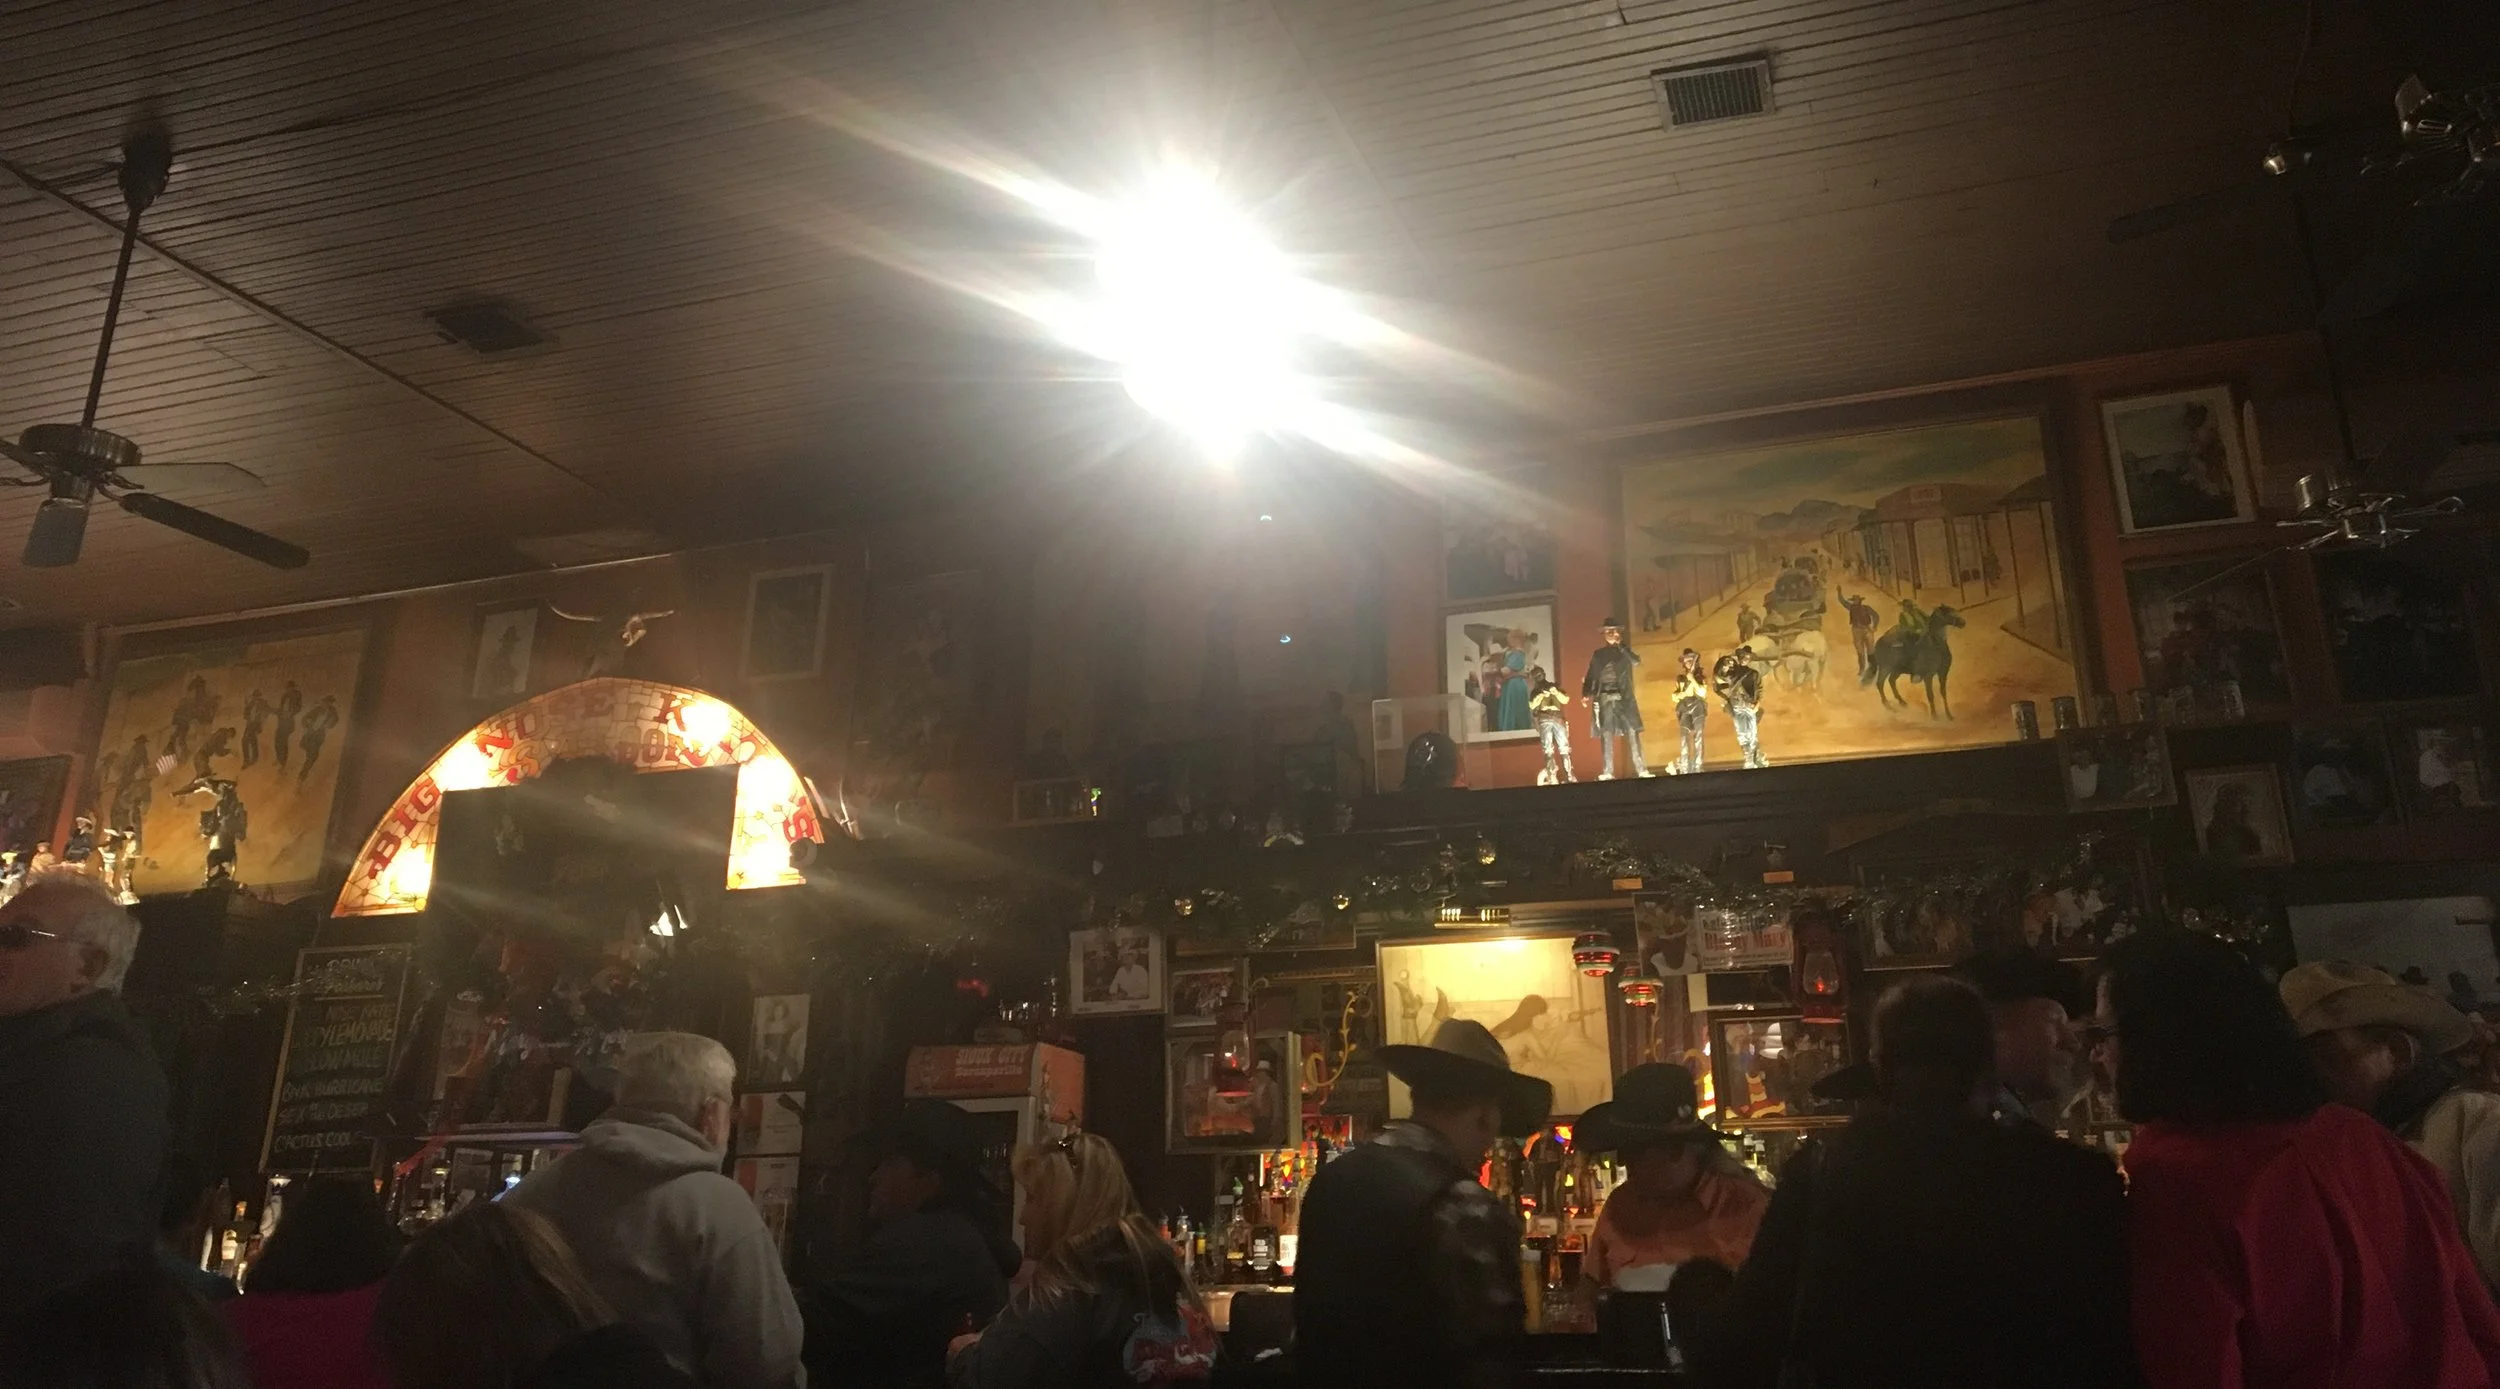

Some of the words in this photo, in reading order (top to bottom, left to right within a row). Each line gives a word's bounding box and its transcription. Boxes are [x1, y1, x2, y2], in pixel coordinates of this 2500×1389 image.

[367, 777, 442, 880] BIG
[475, 686, 618, 759] NOSE
[997, 1044, 1030, 1064] CITY
